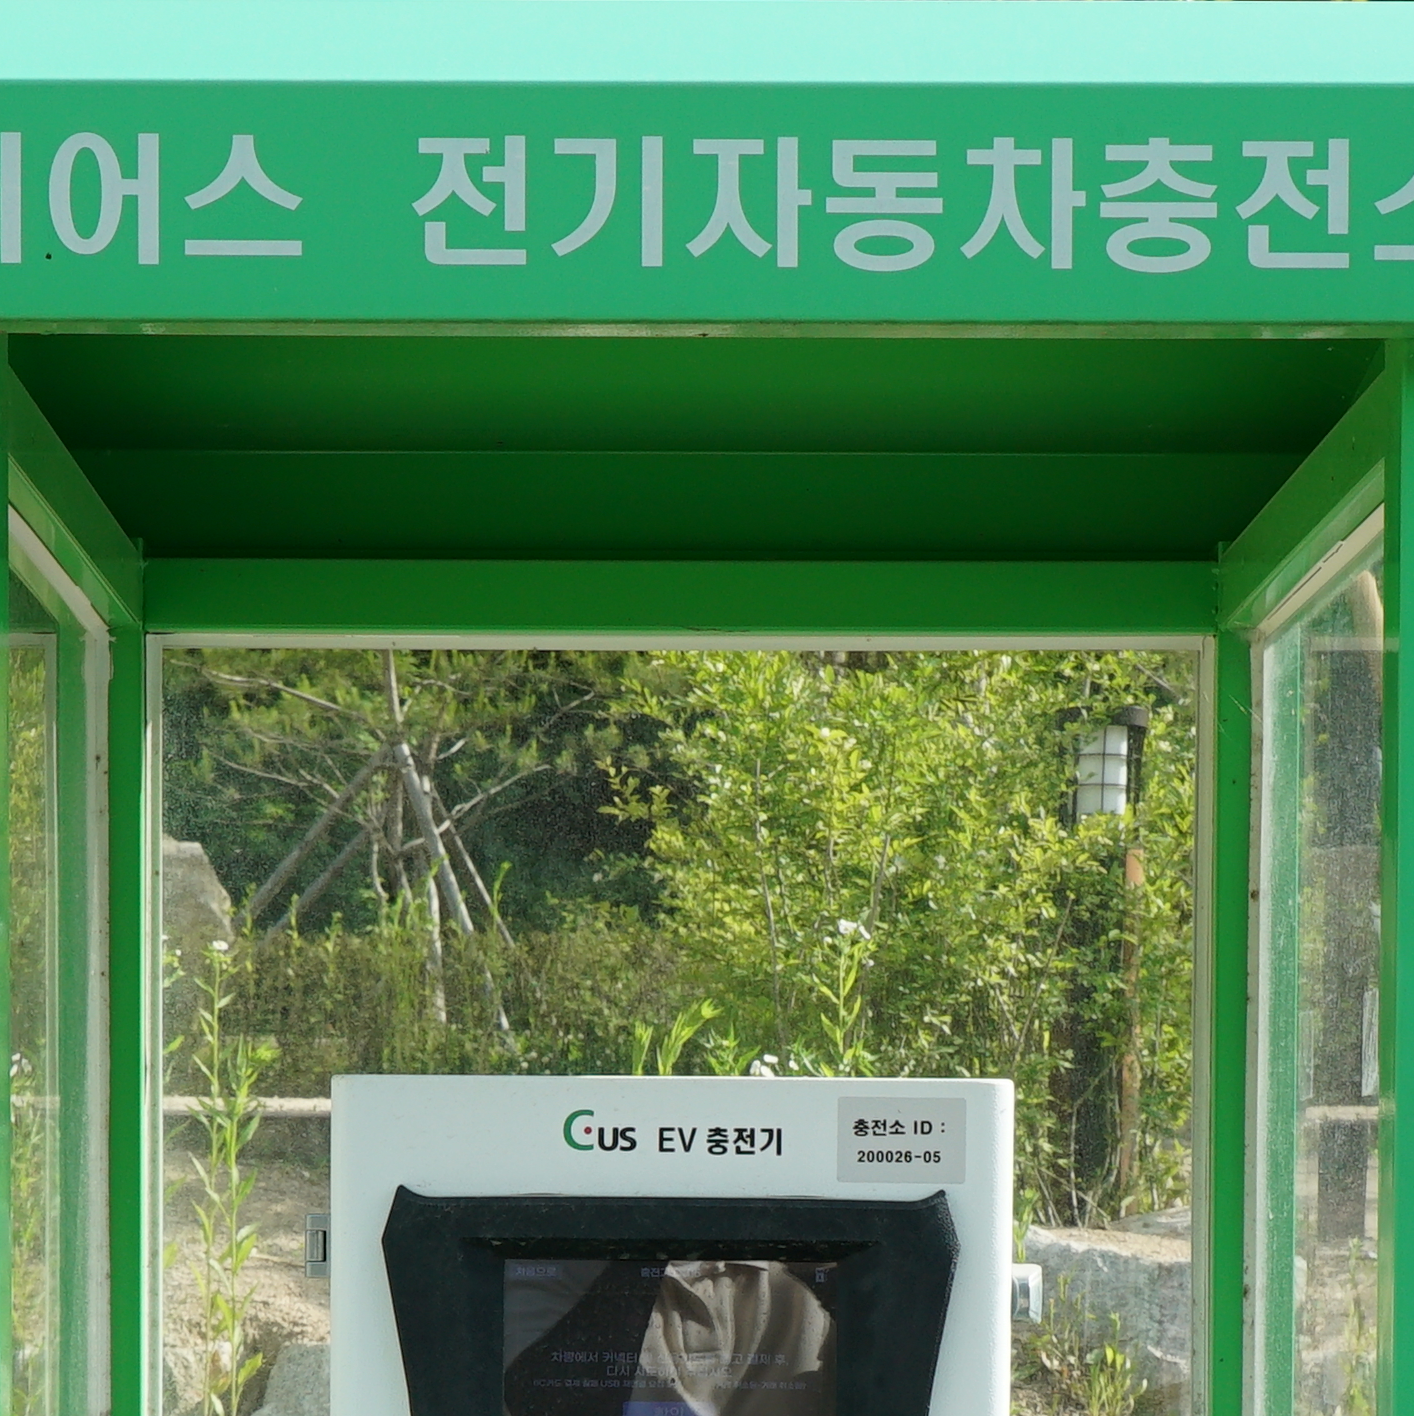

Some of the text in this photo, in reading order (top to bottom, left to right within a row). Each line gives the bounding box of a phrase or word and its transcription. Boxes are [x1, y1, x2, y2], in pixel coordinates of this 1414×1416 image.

[852, 1118, 906, 1137] 충전소
[913, 1120, 933, 1135] ID
[658, 1127, 697, 1152] EV
[706, 1127, 782, 1156] 충전기
[856, 1150, 942, 1163] 200026-05
[606, 1364, 630, 1377] 다시
